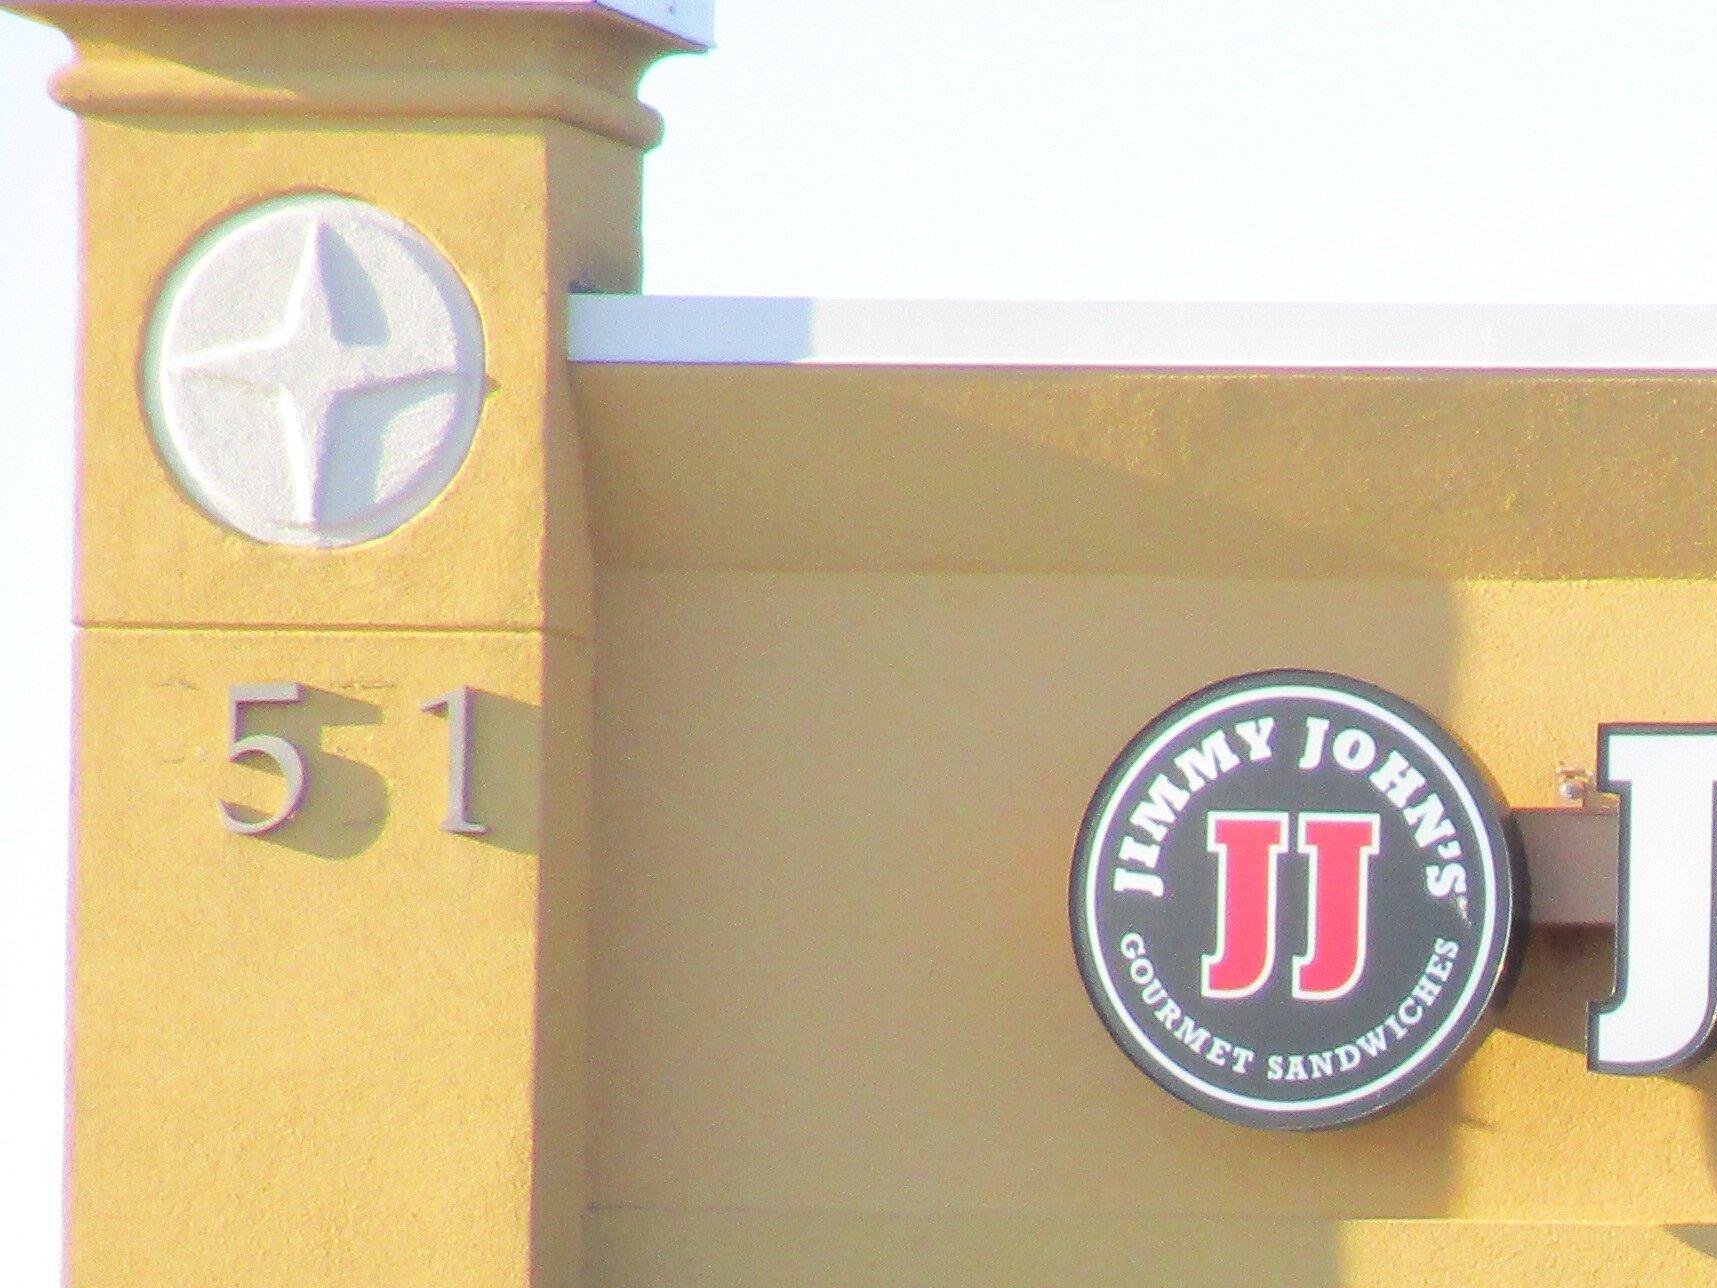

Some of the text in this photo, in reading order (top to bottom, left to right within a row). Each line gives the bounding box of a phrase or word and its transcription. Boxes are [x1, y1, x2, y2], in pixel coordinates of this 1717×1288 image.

[217, 683, 491, 835] 51
[1114, 716, 1469, 901] JIMMY JOHN'S
[1200, 811, 1381, 1000] JJ
[1119, 932, 1459, 1082] GOURMET SANDWICHES
